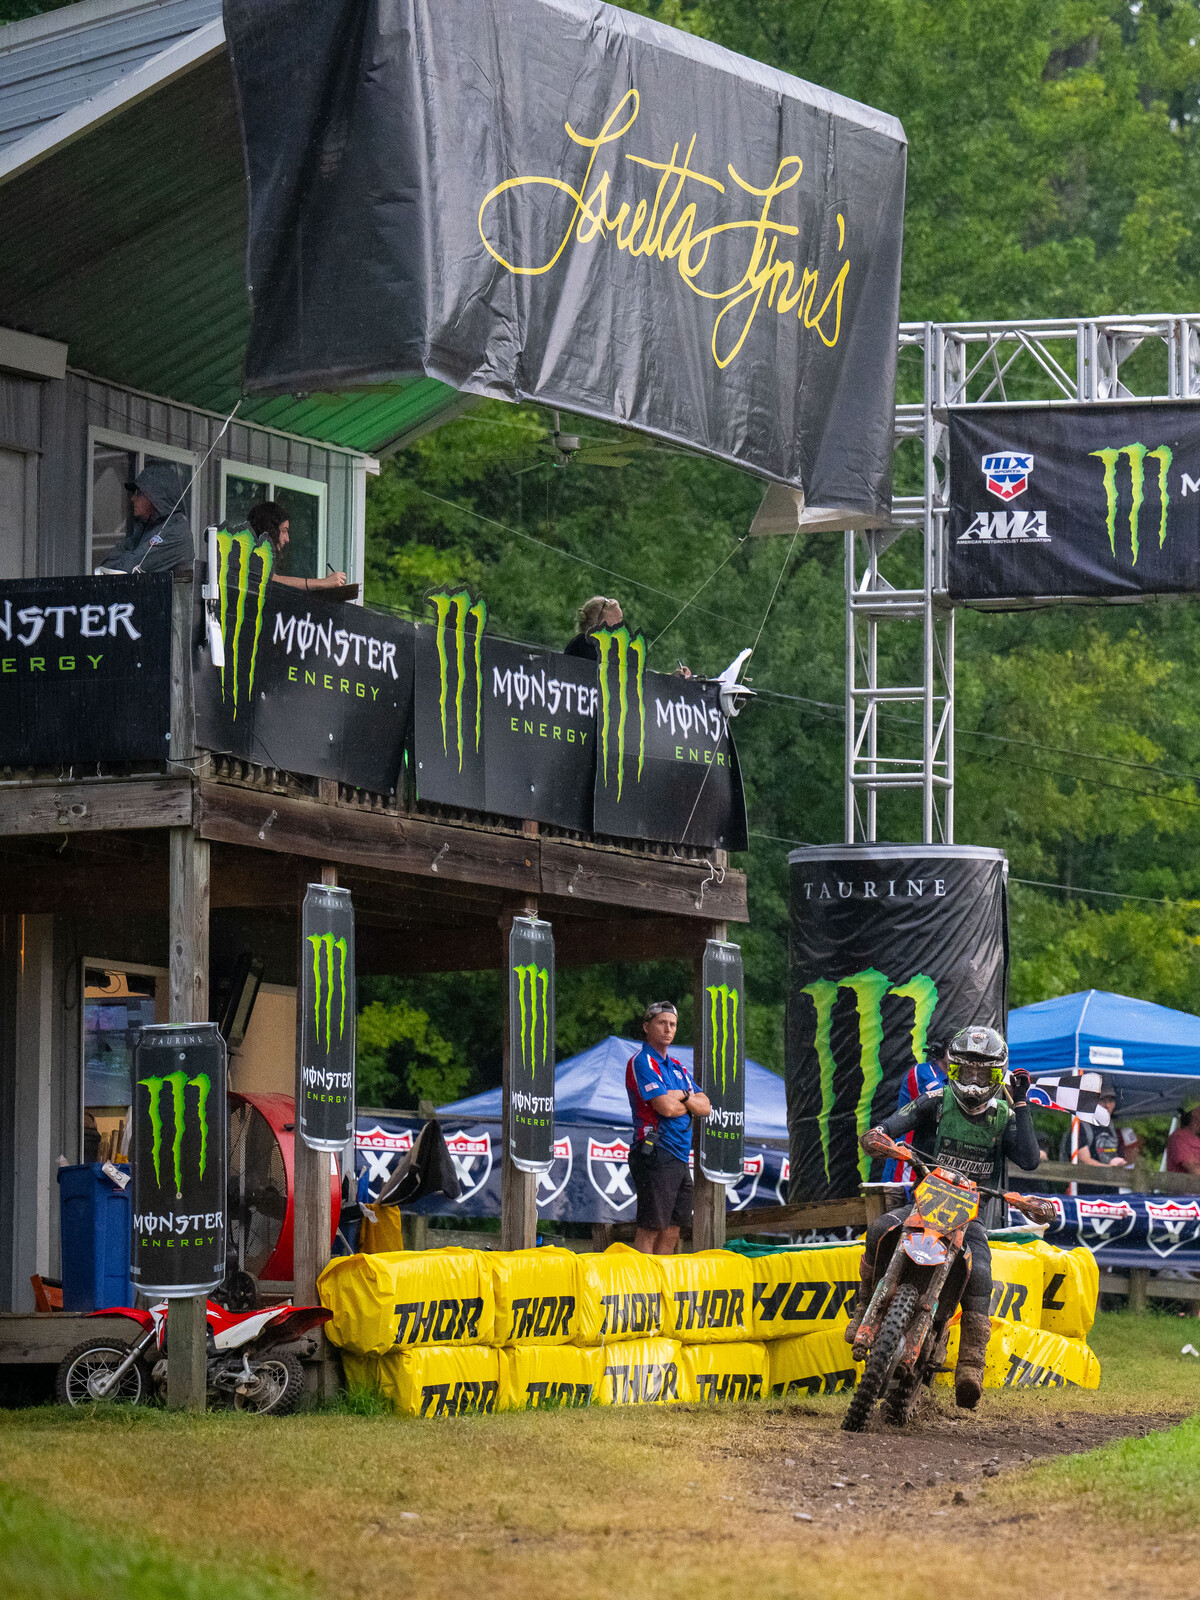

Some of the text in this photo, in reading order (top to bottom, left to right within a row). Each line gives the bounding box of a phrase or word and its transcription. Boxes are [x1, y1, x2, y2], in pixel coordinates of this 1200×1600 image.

[478, 89, 850, 369] Loretta Lynn's
[957, 511, 1052, 539] AMA
[288, 666, 379, 701] ENERGY
[510, 717, 588, 745] ENERGY
[675, 746, 732, 767] ENER
[803, 879, 947, 900] TAURINE
[151, 1036, 203, 1046] TAURINE
[307, 1091, 347, 1103] ENERGY
[515, 1115, 550, 1127] ENERGY
[705, 1105, 744, 1128] ONSTER
[706, 1128, 740, 1139] ENERGY
[604, 1162, 633, 1195] X
[1151, 1208, 1197, 1217] RACER
[142, 1237, 214, 1247] ENERGY
[394, 1297, 484, 1345] THOR
[507, 1296, 576, 1340] THOR
[600, 1292, 661, 1336] THOR
[674, 1289, 745, 1331] THOR
[603, 1362, 680, 1405] THOR
